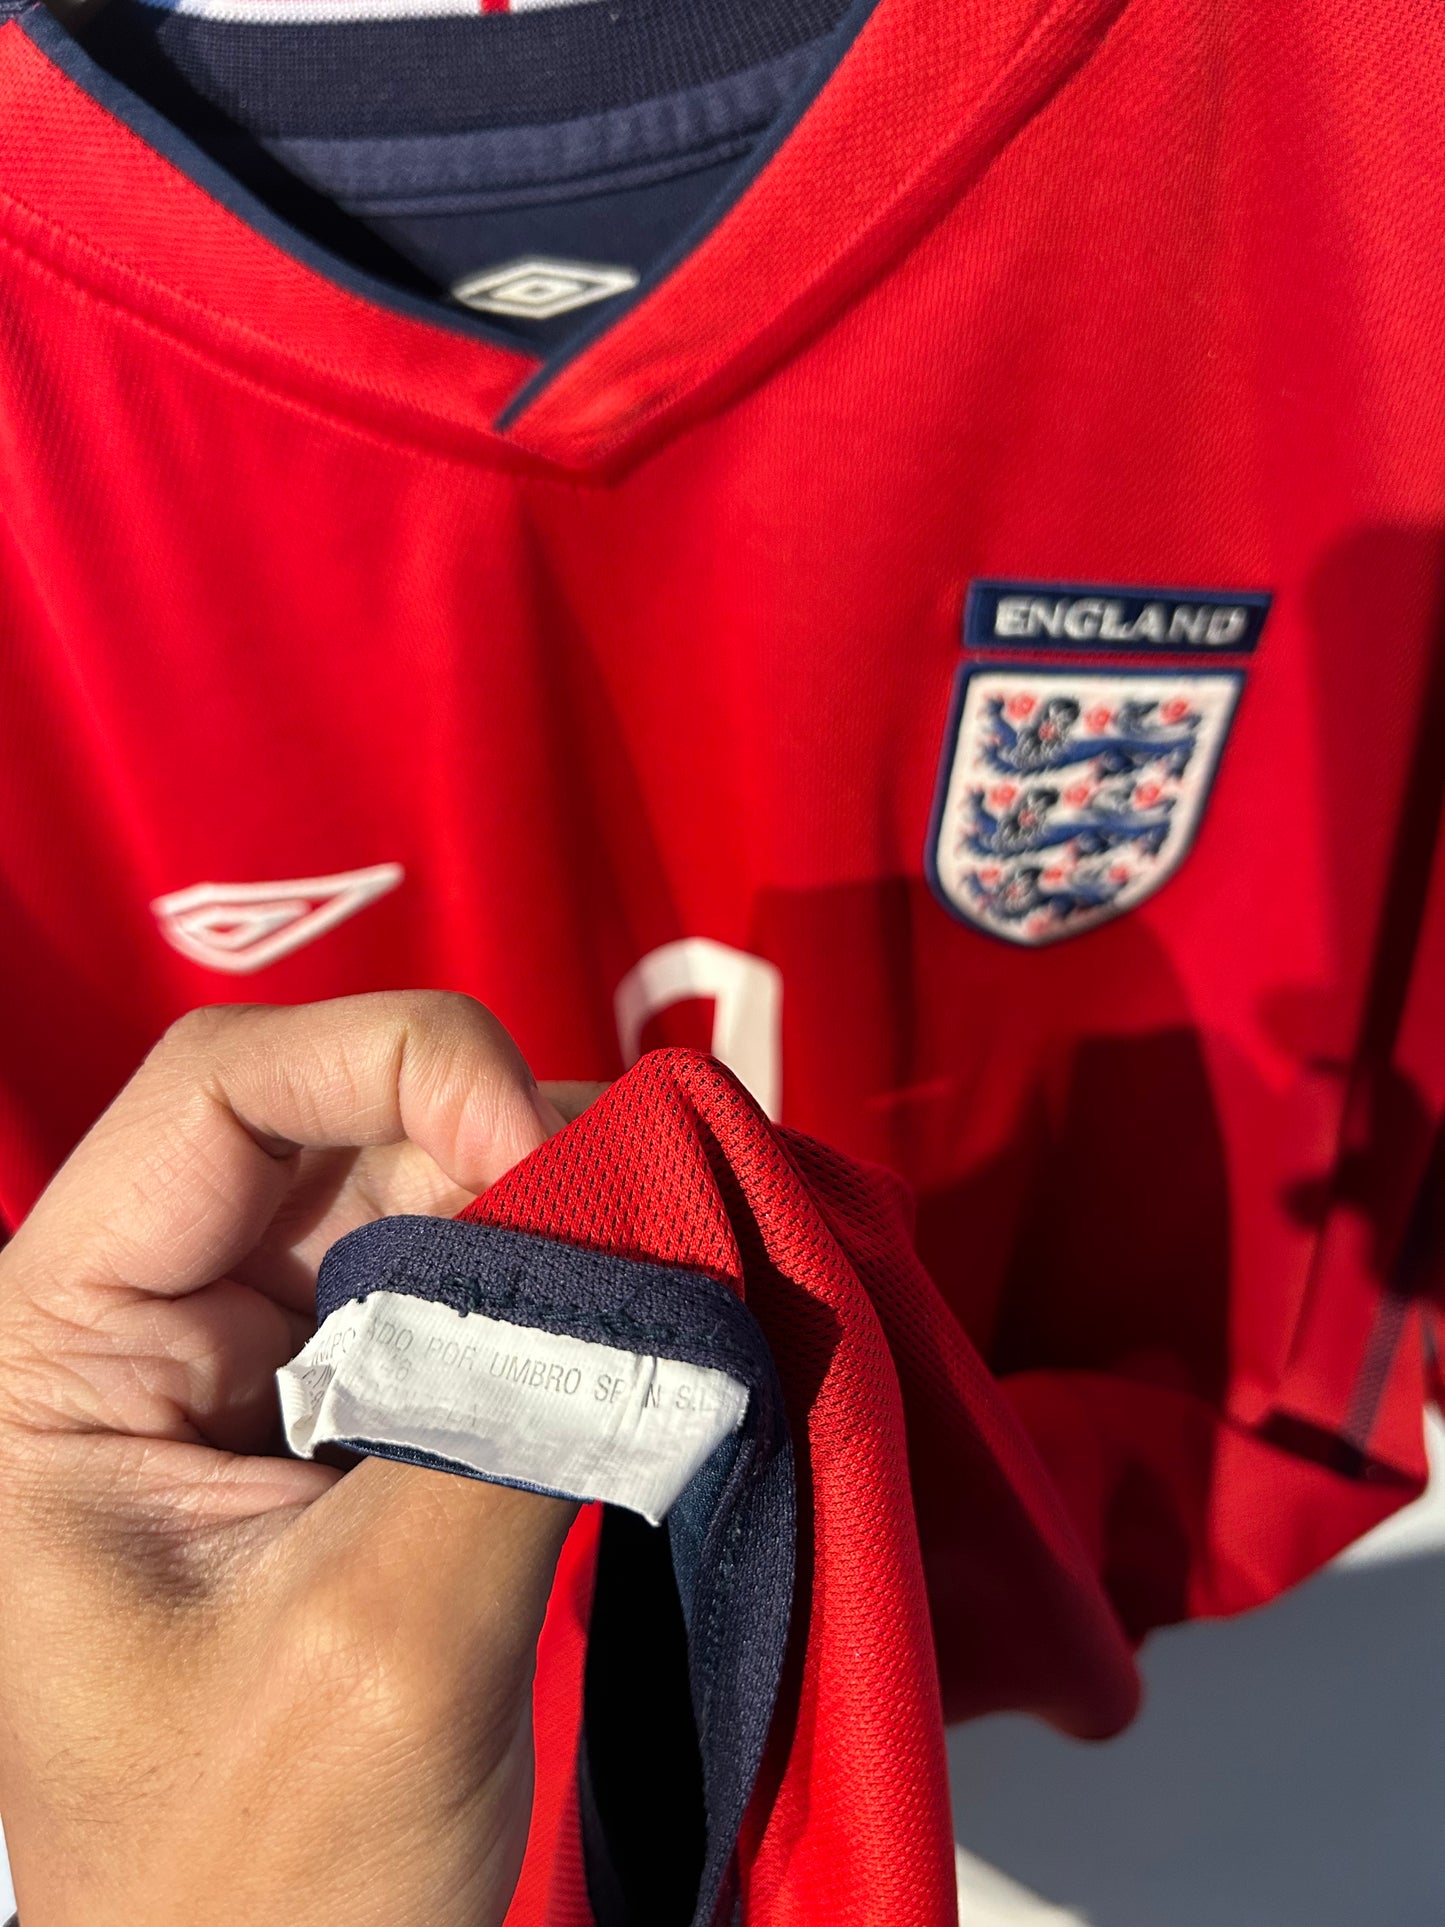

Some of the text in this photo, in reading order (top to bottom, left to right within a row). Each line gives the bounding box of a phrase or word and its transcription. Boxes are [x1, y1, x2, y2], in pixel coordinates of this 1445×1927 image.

[994, 597, 1247, 645] ENGLAND
[425, 1336, 477, 1371] POR
[489, 1350, 583, 1397] UMBRO
[593, 1373, 661, 1409] SPN
